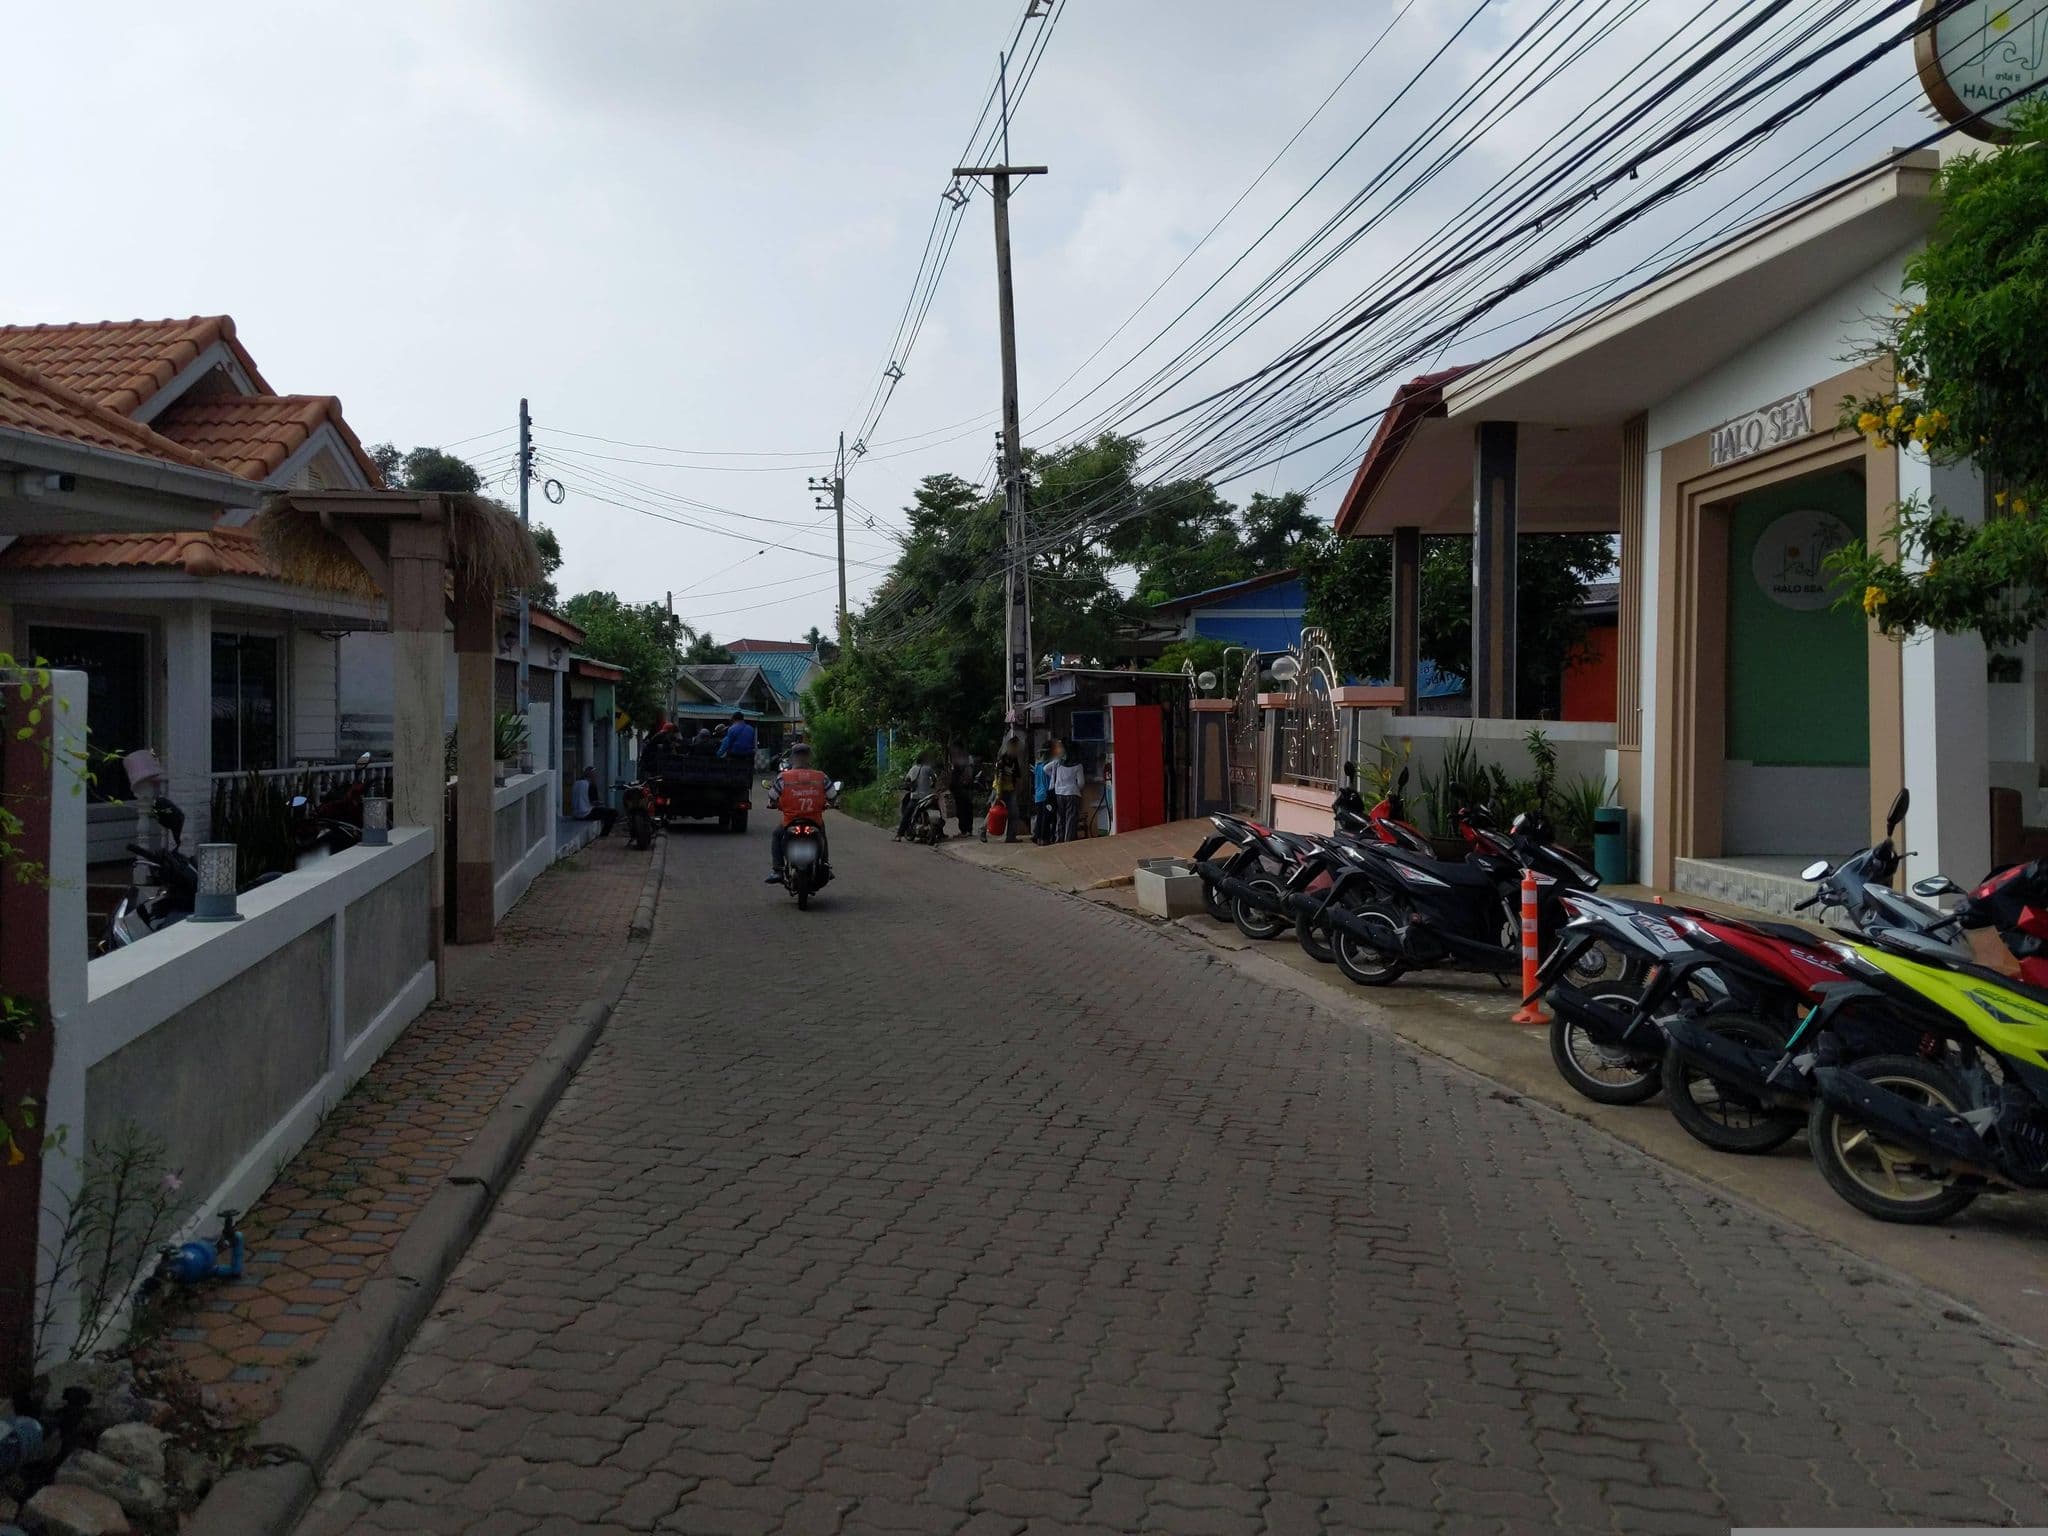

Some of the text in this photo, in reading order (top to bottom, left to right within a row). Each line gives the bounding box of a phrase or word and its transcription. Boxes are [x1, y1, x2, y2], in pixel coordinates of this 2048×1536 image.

[1963, 83, 2012, 101] HALO
[1710, 399, 1811, 464] HALO SEA
[1773, 583, 1825, 593] HALO SEA
[798, 797, 814, 812] 72
